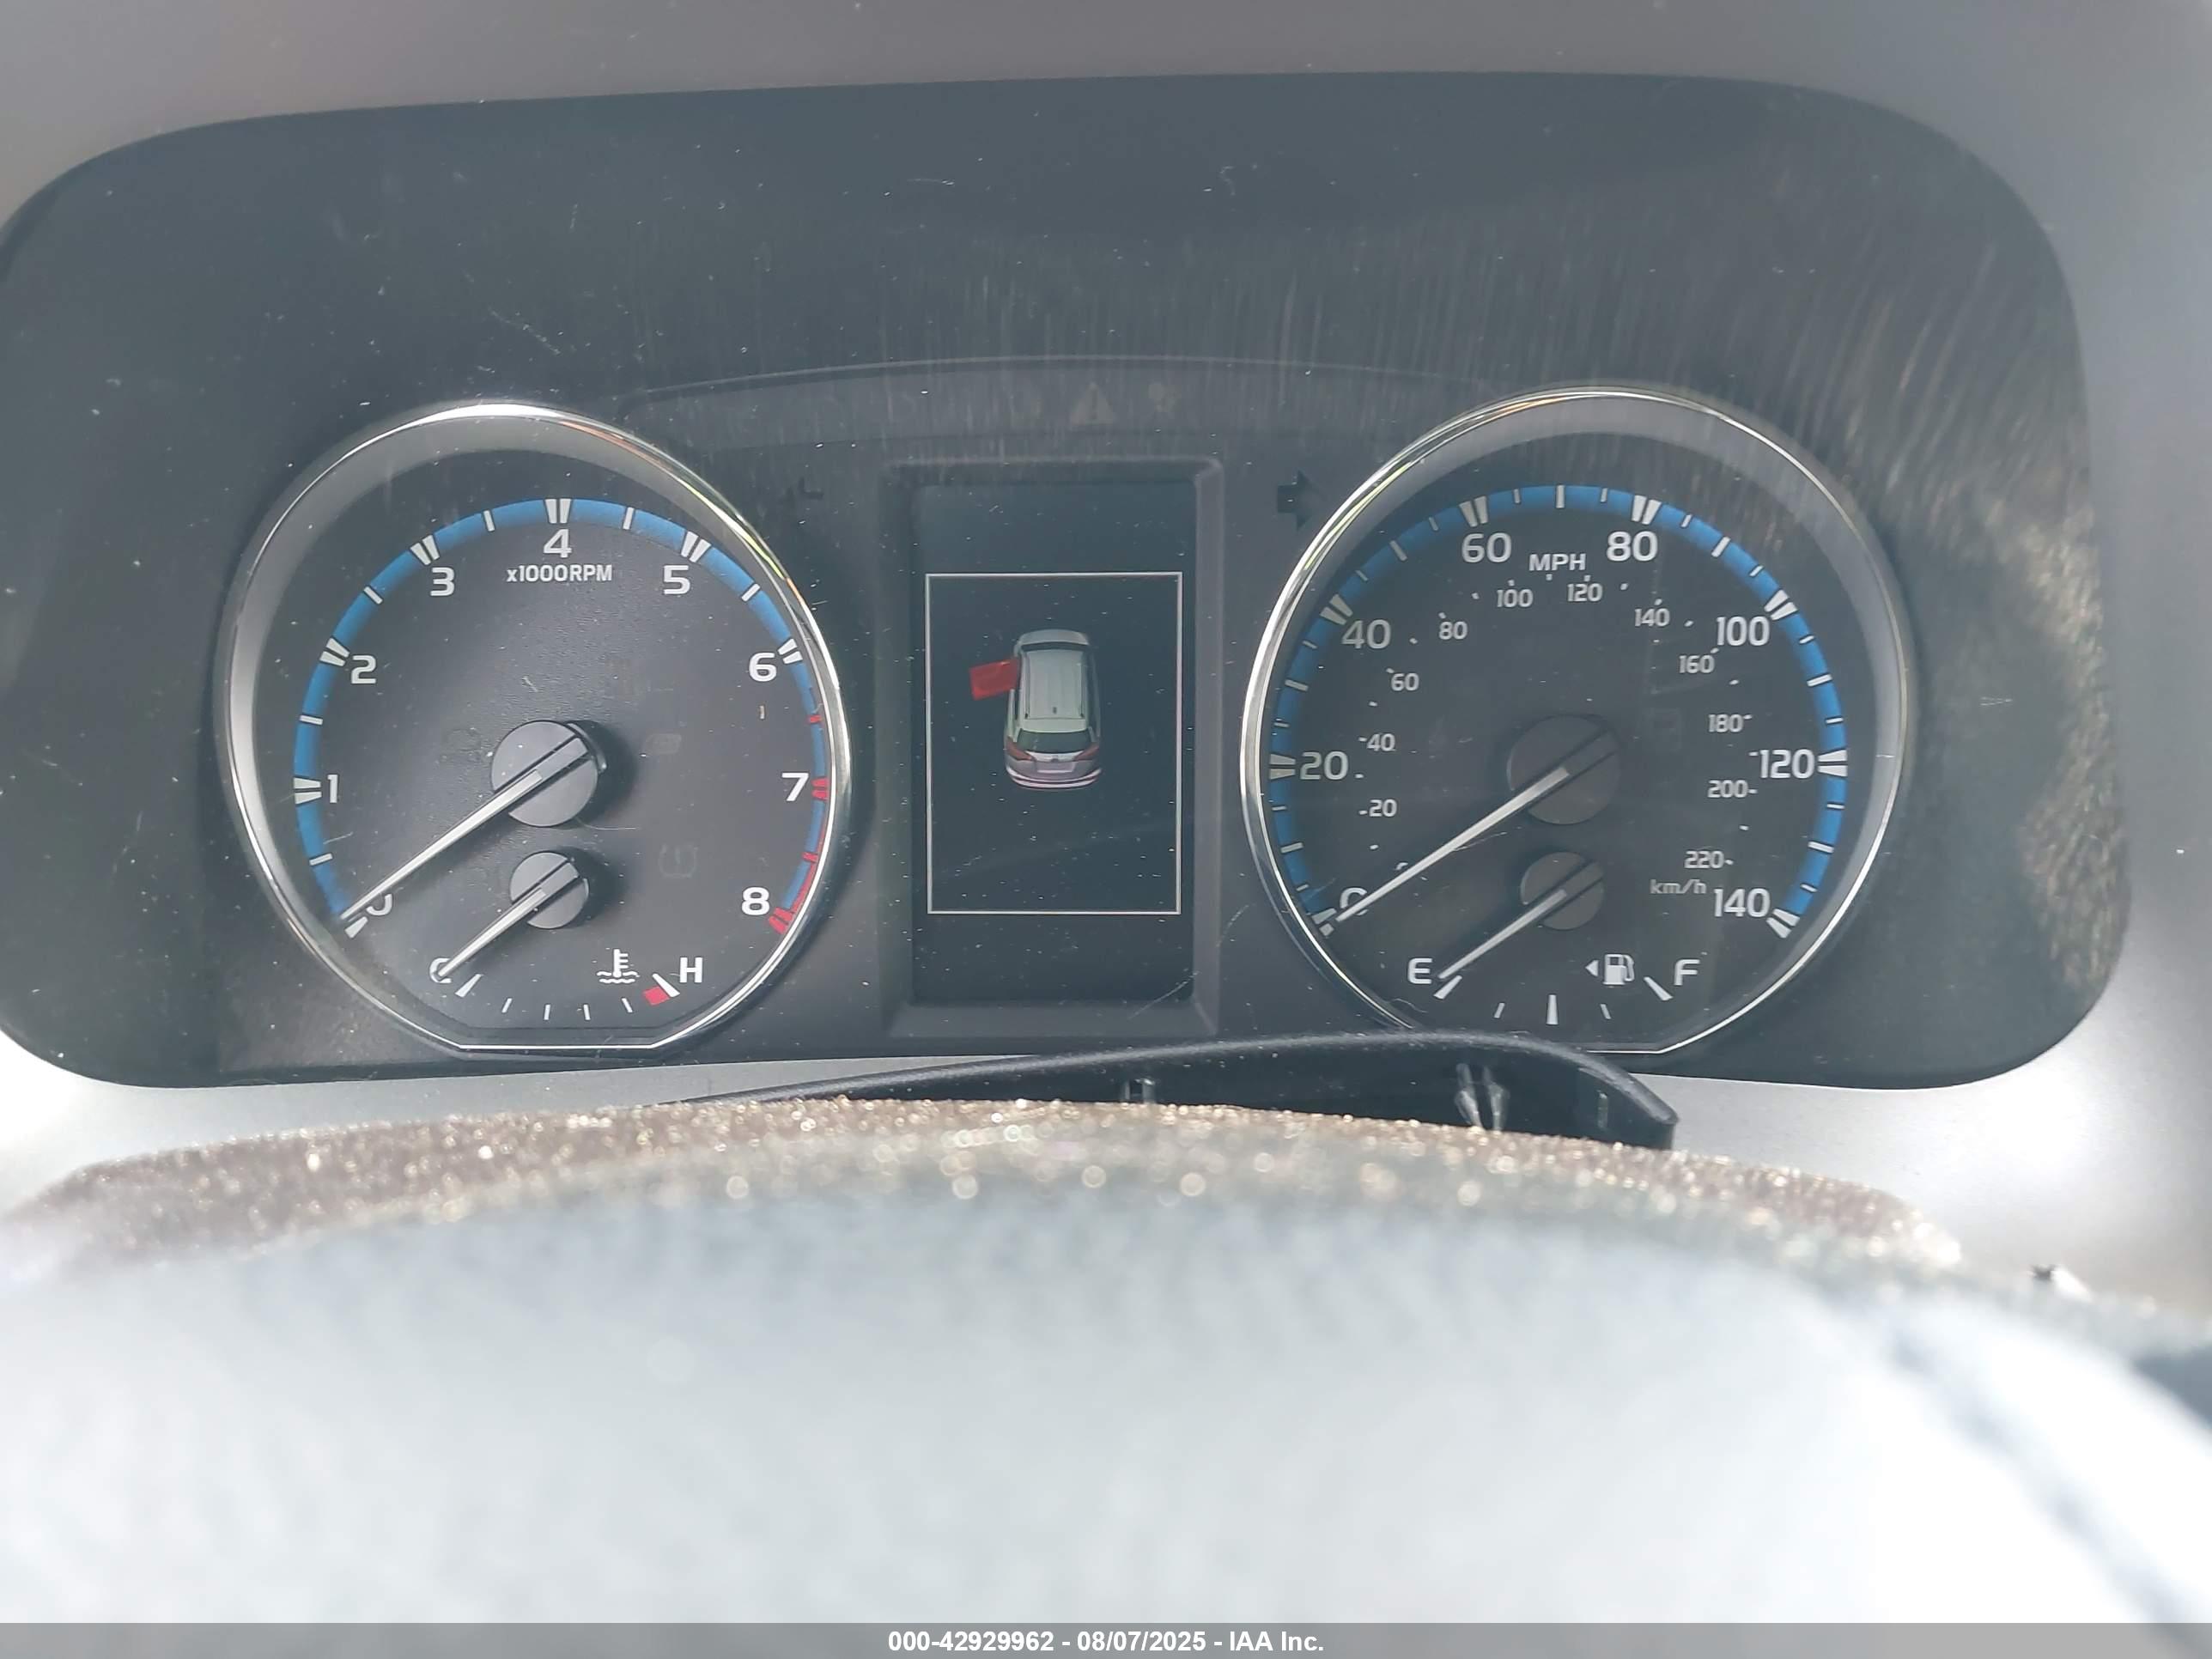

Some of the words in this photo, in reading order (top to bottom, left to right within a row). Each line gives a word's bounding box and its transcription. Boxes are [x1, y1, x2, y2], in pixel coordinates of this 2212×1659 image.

[544, 528, 572, 558] 4
[1462, 532, 1511, 563] 60
[1607, 531, 1657, 562] 80
[507, 564, 612, 582] x1000RPM
[1529, 553, 1586, 571] MPH
[431, 567, 456, 597] 3
[663, 564, 690, 595] 5
[1567, 583, 1602, 602] 120
[1497, 588, 1534, 608] 100
[1439, 621, 1468, 640] 80
[1635, 608, 1670, 627] 140
[1340, 617, 1391, 649] 40
[1716, 617, 1771, 647] 100
[351, 654, 376, 684] 2
[749, 651, 778, 683] 6
[1679, 654, 1714, 674] 160
[1390, 672, 1419, 691] 60
[1709, 714, 1743, 732] 180
[1367, 733, 1395, 751] 40
[1301, 750, 1348, 781] 20
[1759, 749, 1814, 779] 120
[327, 774, 338, 804] 1
[781, 772, 809, 802] 7
[1708, 780, 1747, 798] 200
[1370, 799, 1397, 817] 20
[1685, 850, 1727, 869] 220
[1651, 878, 1707, 894] km/h
[741, 886, 770, 915] 8
[1714, 888, 1769, 919] 140
[429, 957, 452, 984] C
[679, 957, 703, 983] H
[1408, 957, 1432, 984] E
[1674, 959, 1700, 986] F
